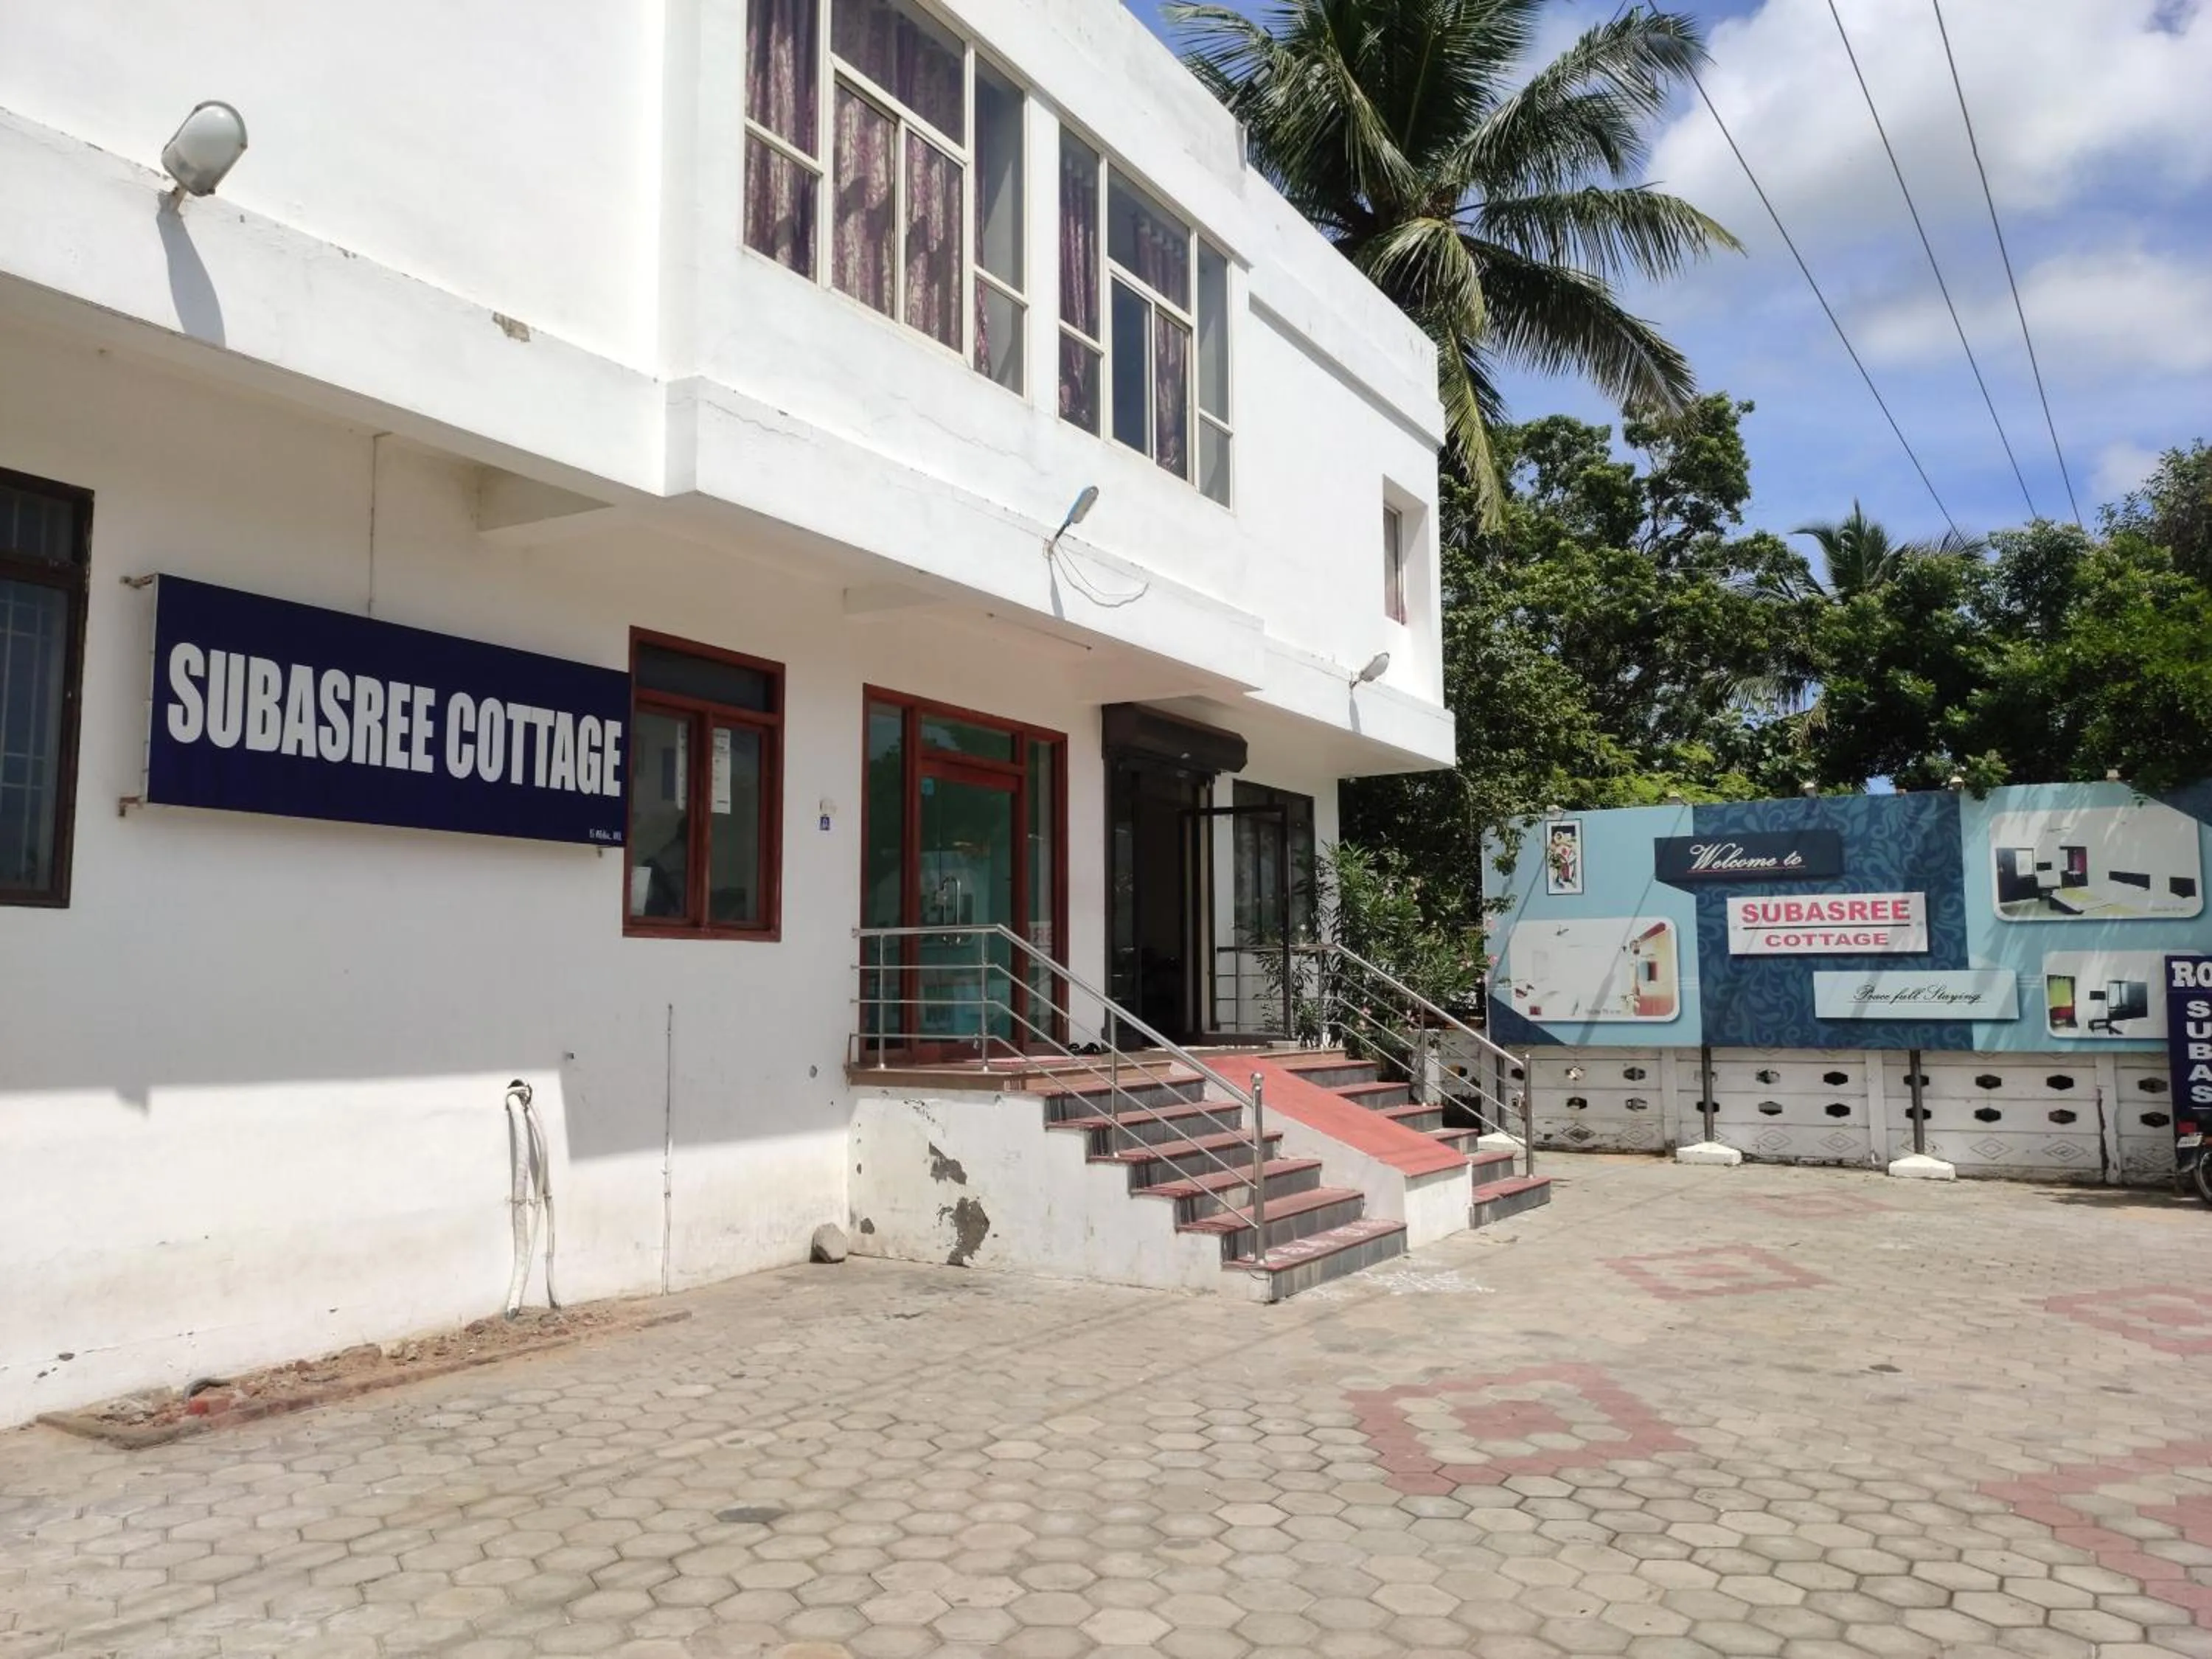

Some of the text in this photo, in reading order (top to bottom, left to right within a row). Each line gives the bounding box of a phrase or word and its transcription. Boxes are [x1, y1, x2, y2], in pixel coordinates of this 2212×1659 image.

[167, 642, 622, 797] SUBASREE COTTAGE
[1689, 843, 1804, 871] Welcome to
[1741, 899, 1911, 922] SUBASREE
[1764, 932, 1889, 947] COTTAGE
[2185, 1000, 2212, 1110] SUBAS
